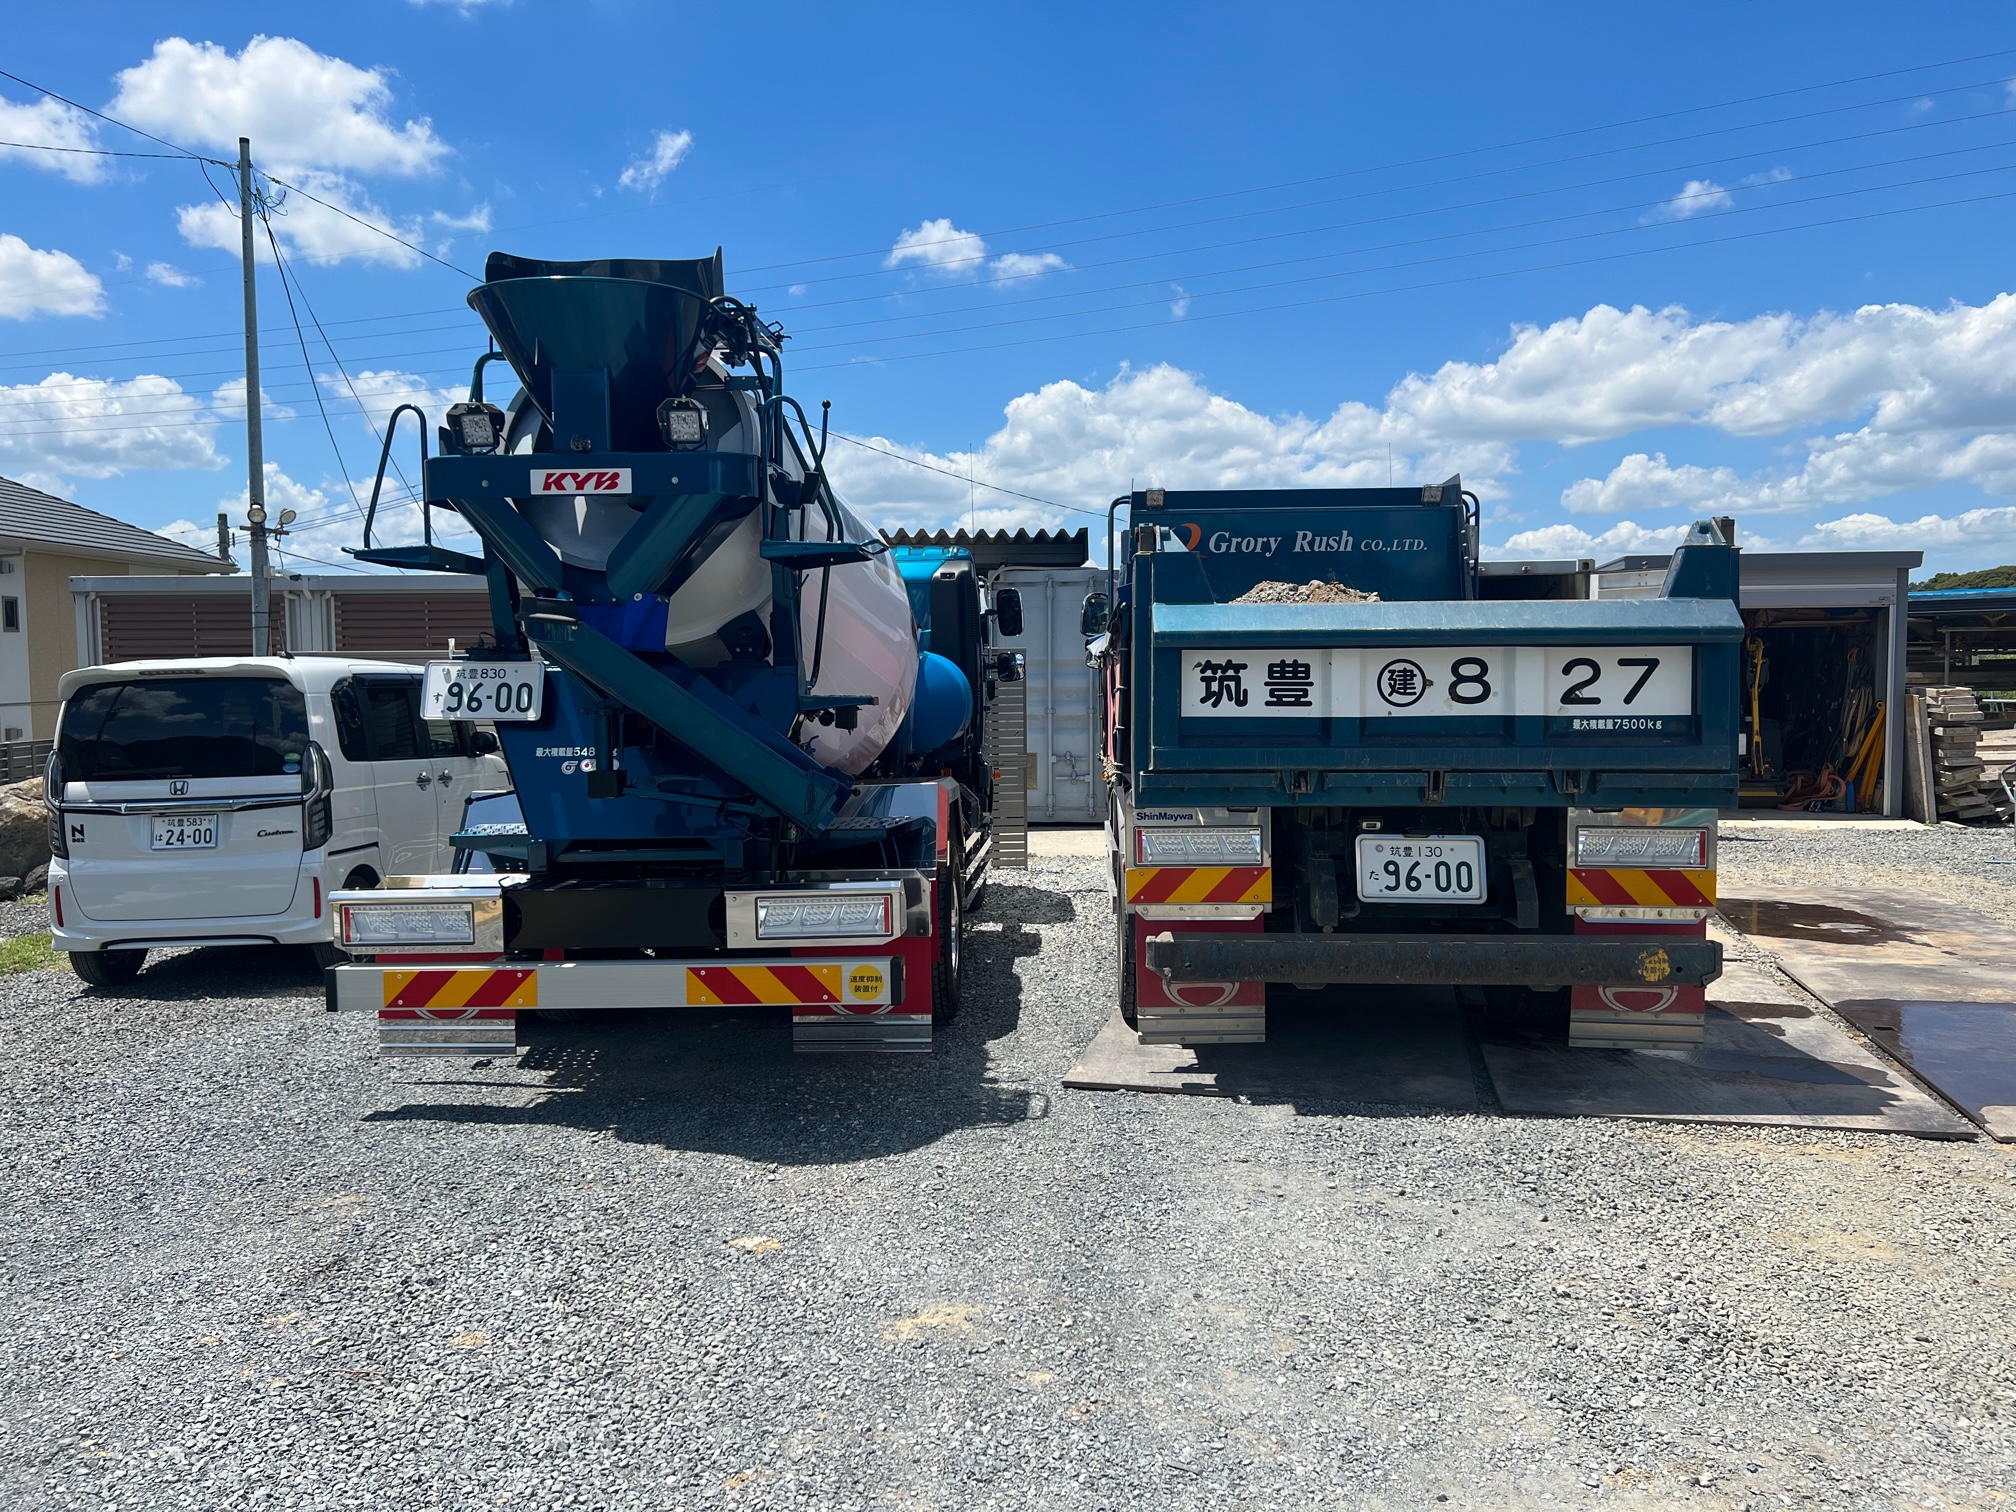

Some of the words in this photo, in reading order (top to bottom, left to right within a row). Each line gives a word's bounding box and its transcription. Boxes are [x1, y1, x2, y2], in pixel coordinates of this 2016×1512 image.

[542, 471, 621, 491] KYB
[1208, 531, 1283, 557] Grory
[1292, 530, 1354, 552] Rush
[1199, 658, 1315, 709] 筑豊
[1448, 656, 1492, 705] 8
[1560, 657, 1661, 705] 27
[433, 691, 443, 703] す
[446, 681, 533, 713] 96-00
[1572, 718, 1663, 730] 最大積載量7500kg
[1136, 811, 1194, 822] ShinMaywa
[71, 823, 85, 838] N
[155, 833, 163, 842] は
[165, 828, 213, 846] 24-00
[257, 829, 297, 838] Custom
[1368, 870, 1380, 881] た
[1383, 860, 1474, 893] 96-00
[850, 975, 883, 983] 速度抑制
[854, 985, 879, 993] 装置付
